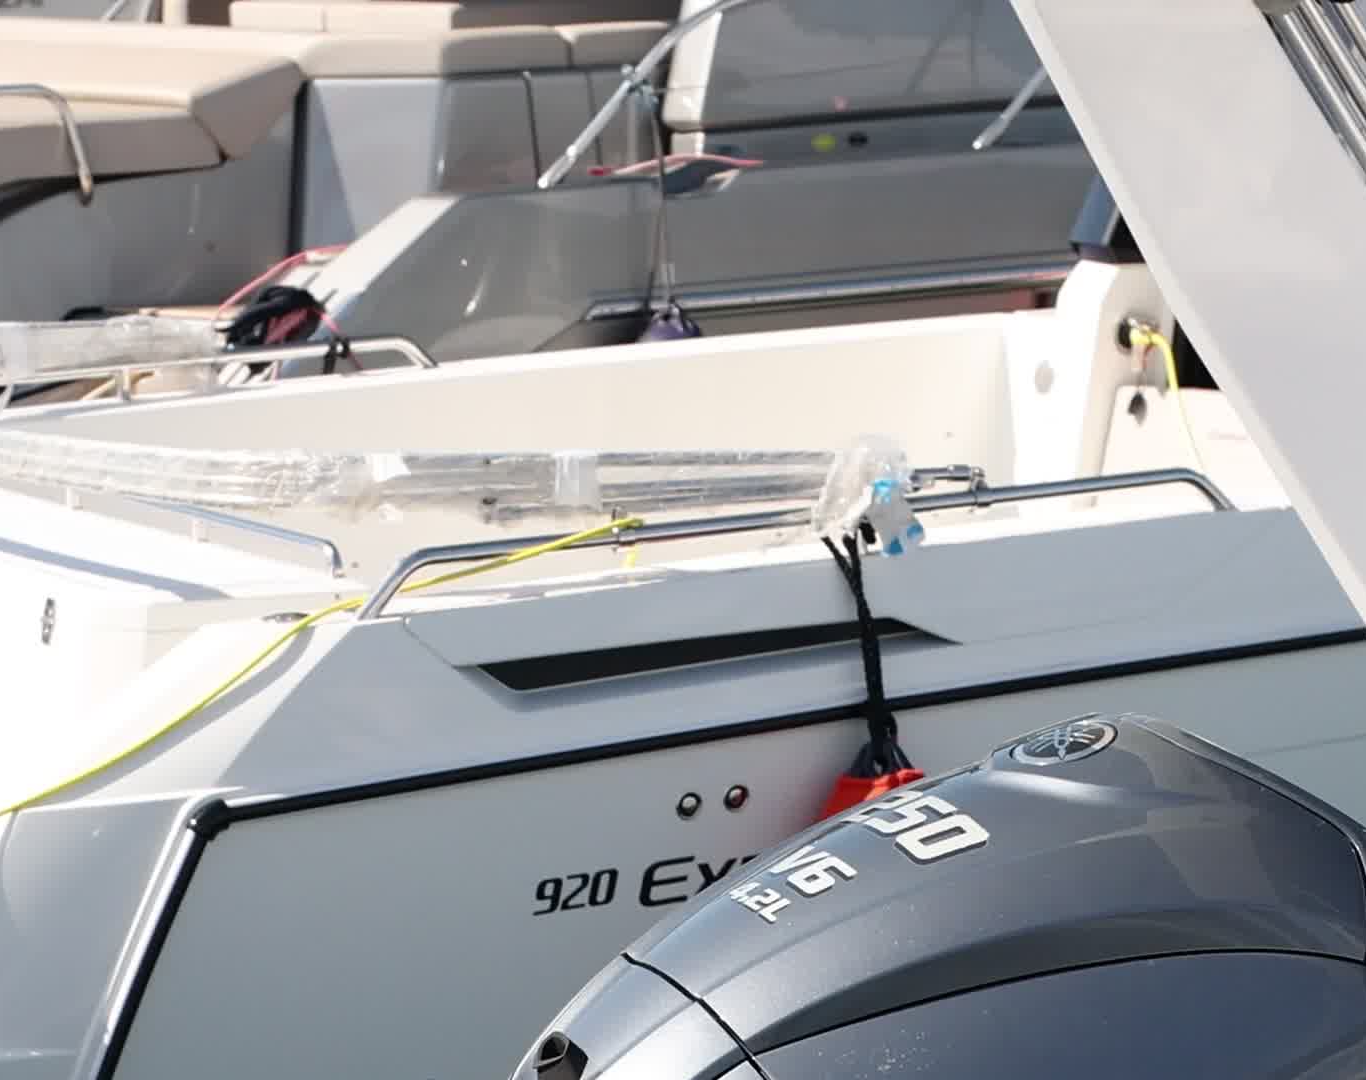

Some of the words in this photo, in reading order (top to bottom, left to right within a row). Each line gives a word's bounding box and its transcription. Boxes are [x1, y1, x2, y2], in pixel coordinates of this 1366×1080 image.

[839, 789, 991, 866] 250
[532, 868, 620, 917] 920
[638, 854, 761, 907] Ex
[768, 841, 858, 898] V6
